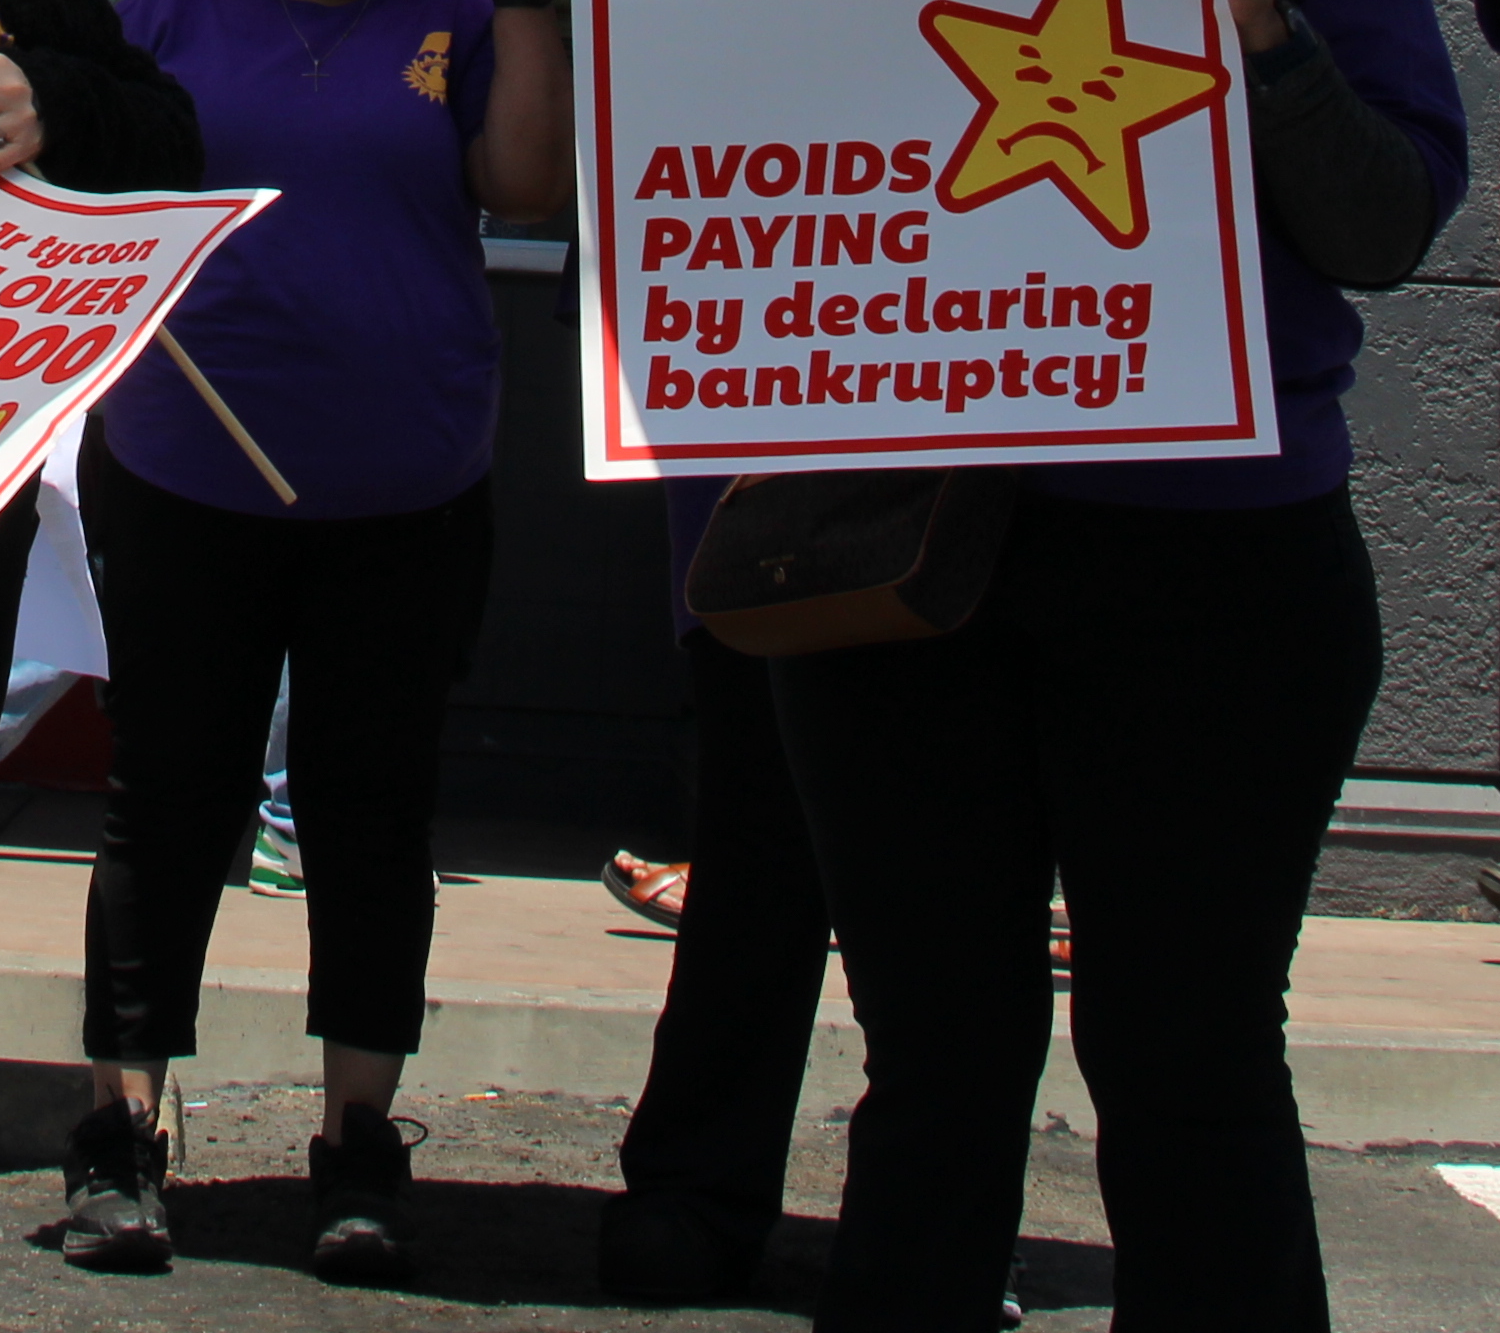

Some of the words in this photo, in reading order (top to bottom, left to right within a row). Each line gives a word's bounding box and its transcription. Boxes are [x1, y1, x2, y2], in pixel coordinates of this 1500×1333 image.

[634, 140, 933, 201] AVOIDS
[29, 232, 159, 270] tycoon
[640, 210, 931, 272] PAYING
[643, 285, 743, 355] by
[764, 272, 1153, 340] declaring
[645, 342, 1149, 414] bankruptcy!
